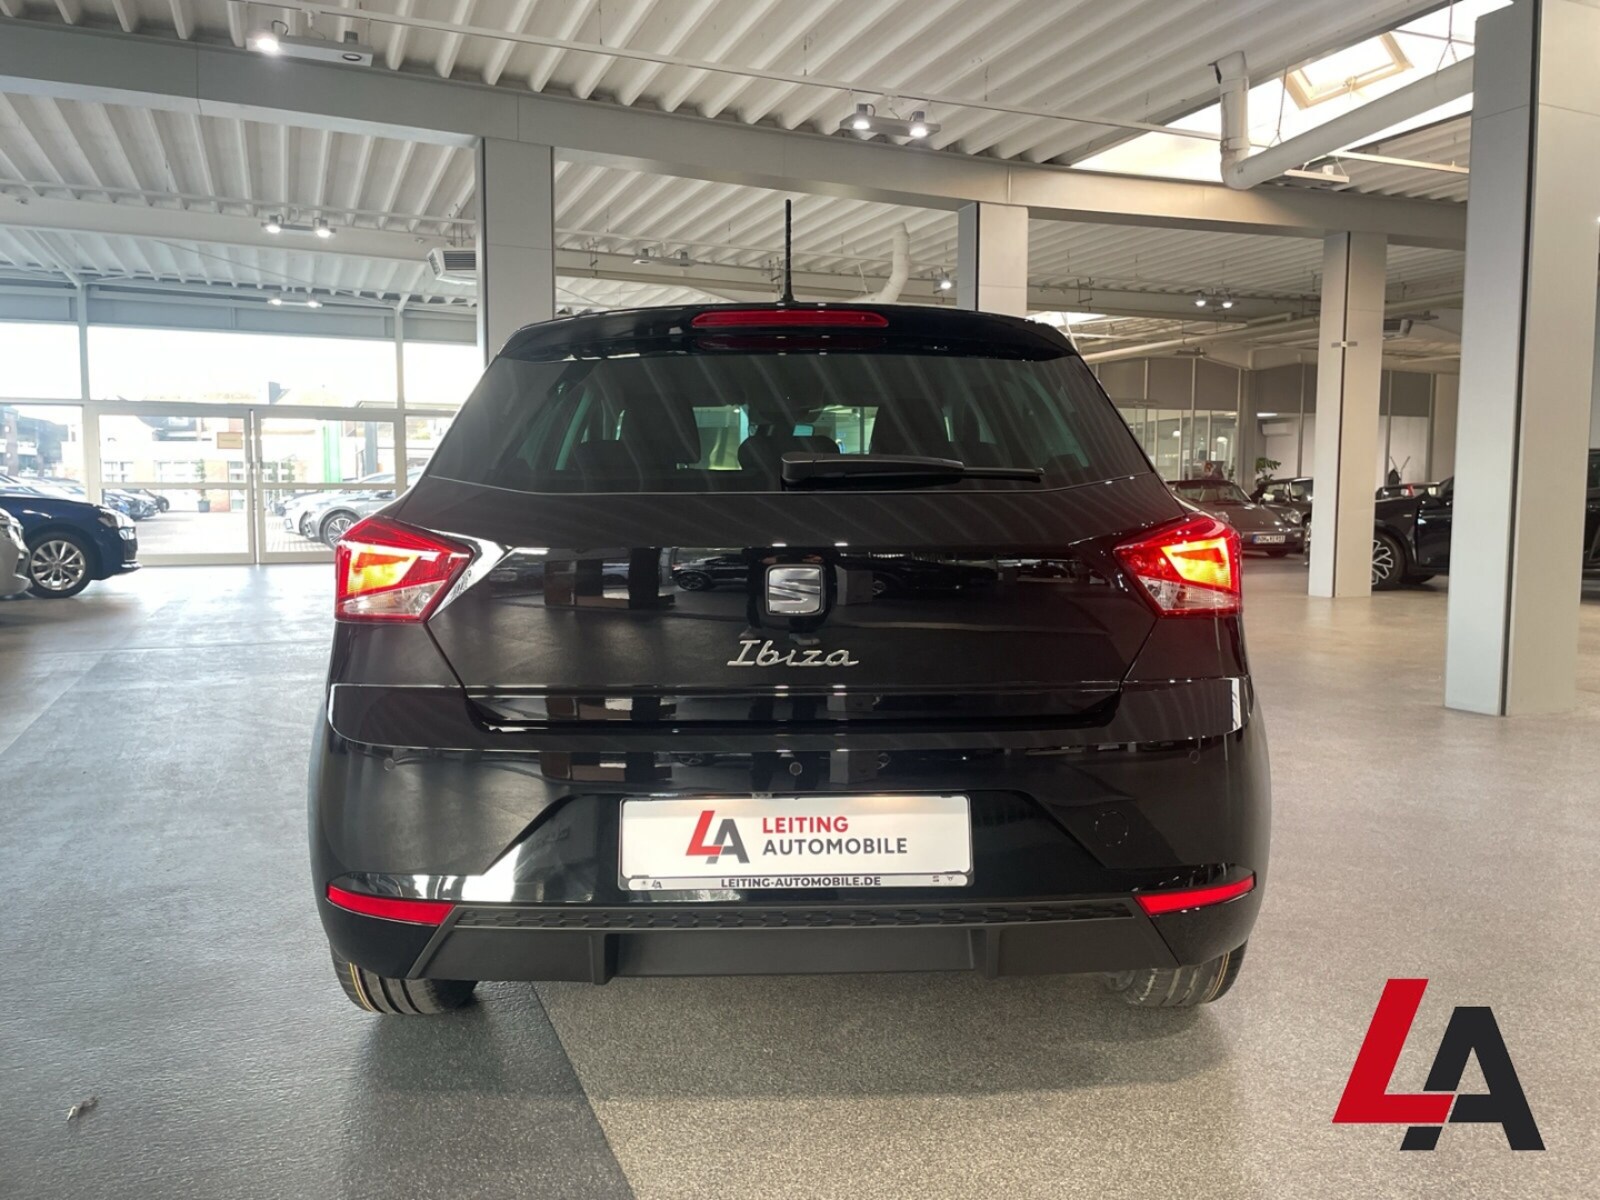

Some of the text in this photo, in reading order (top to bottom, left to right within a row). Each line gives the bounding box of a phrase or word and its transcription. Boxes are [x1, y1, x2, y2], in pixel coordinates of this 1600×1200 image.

[727, 640, 859, 667] Ibiza
[762, 816, 849, 834] LEITING
[762, 838, 908, 856] AUTOMOBILE
[720, 876, 881, 888] LEITING-AUTOMOBILE.DE
